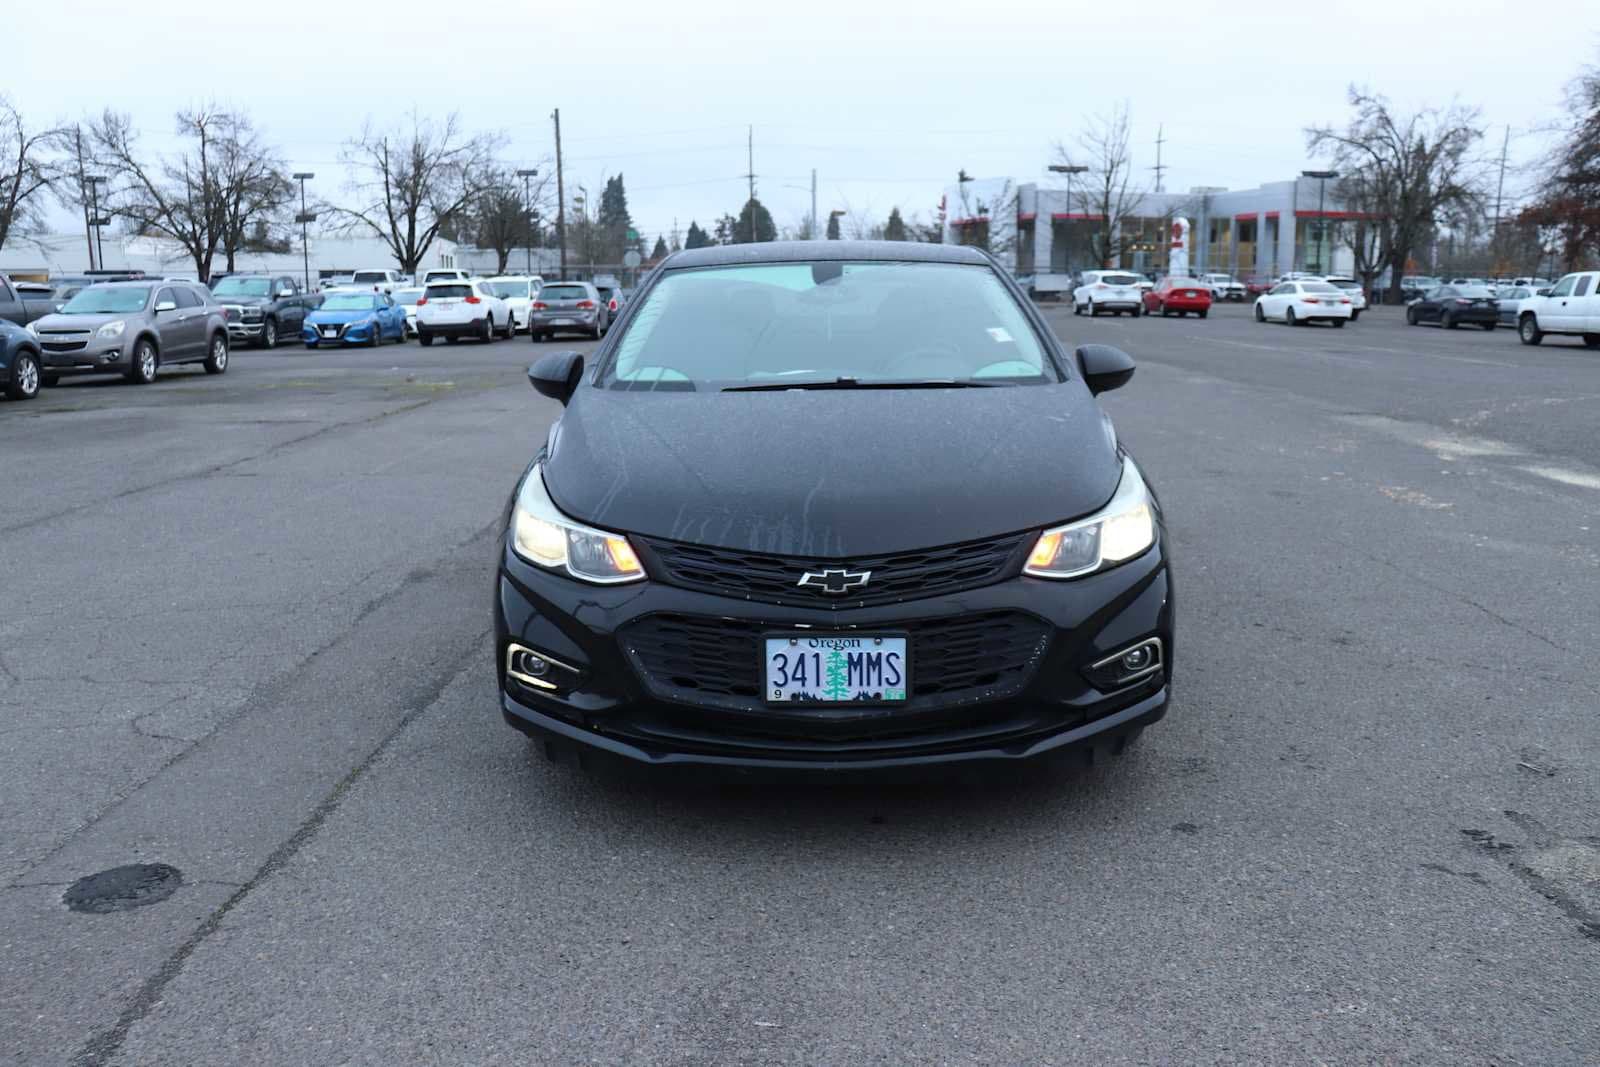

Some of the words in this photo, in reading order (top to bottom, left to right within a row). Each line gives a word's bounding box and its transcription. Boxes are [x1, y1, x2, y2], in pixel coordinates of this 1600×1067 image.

[808, 637, 861, 651] Oregon
[772, 652, 820, 688] 341
[847, 652, 901, 688] MMS
[774, 689, 782, 699] 9
